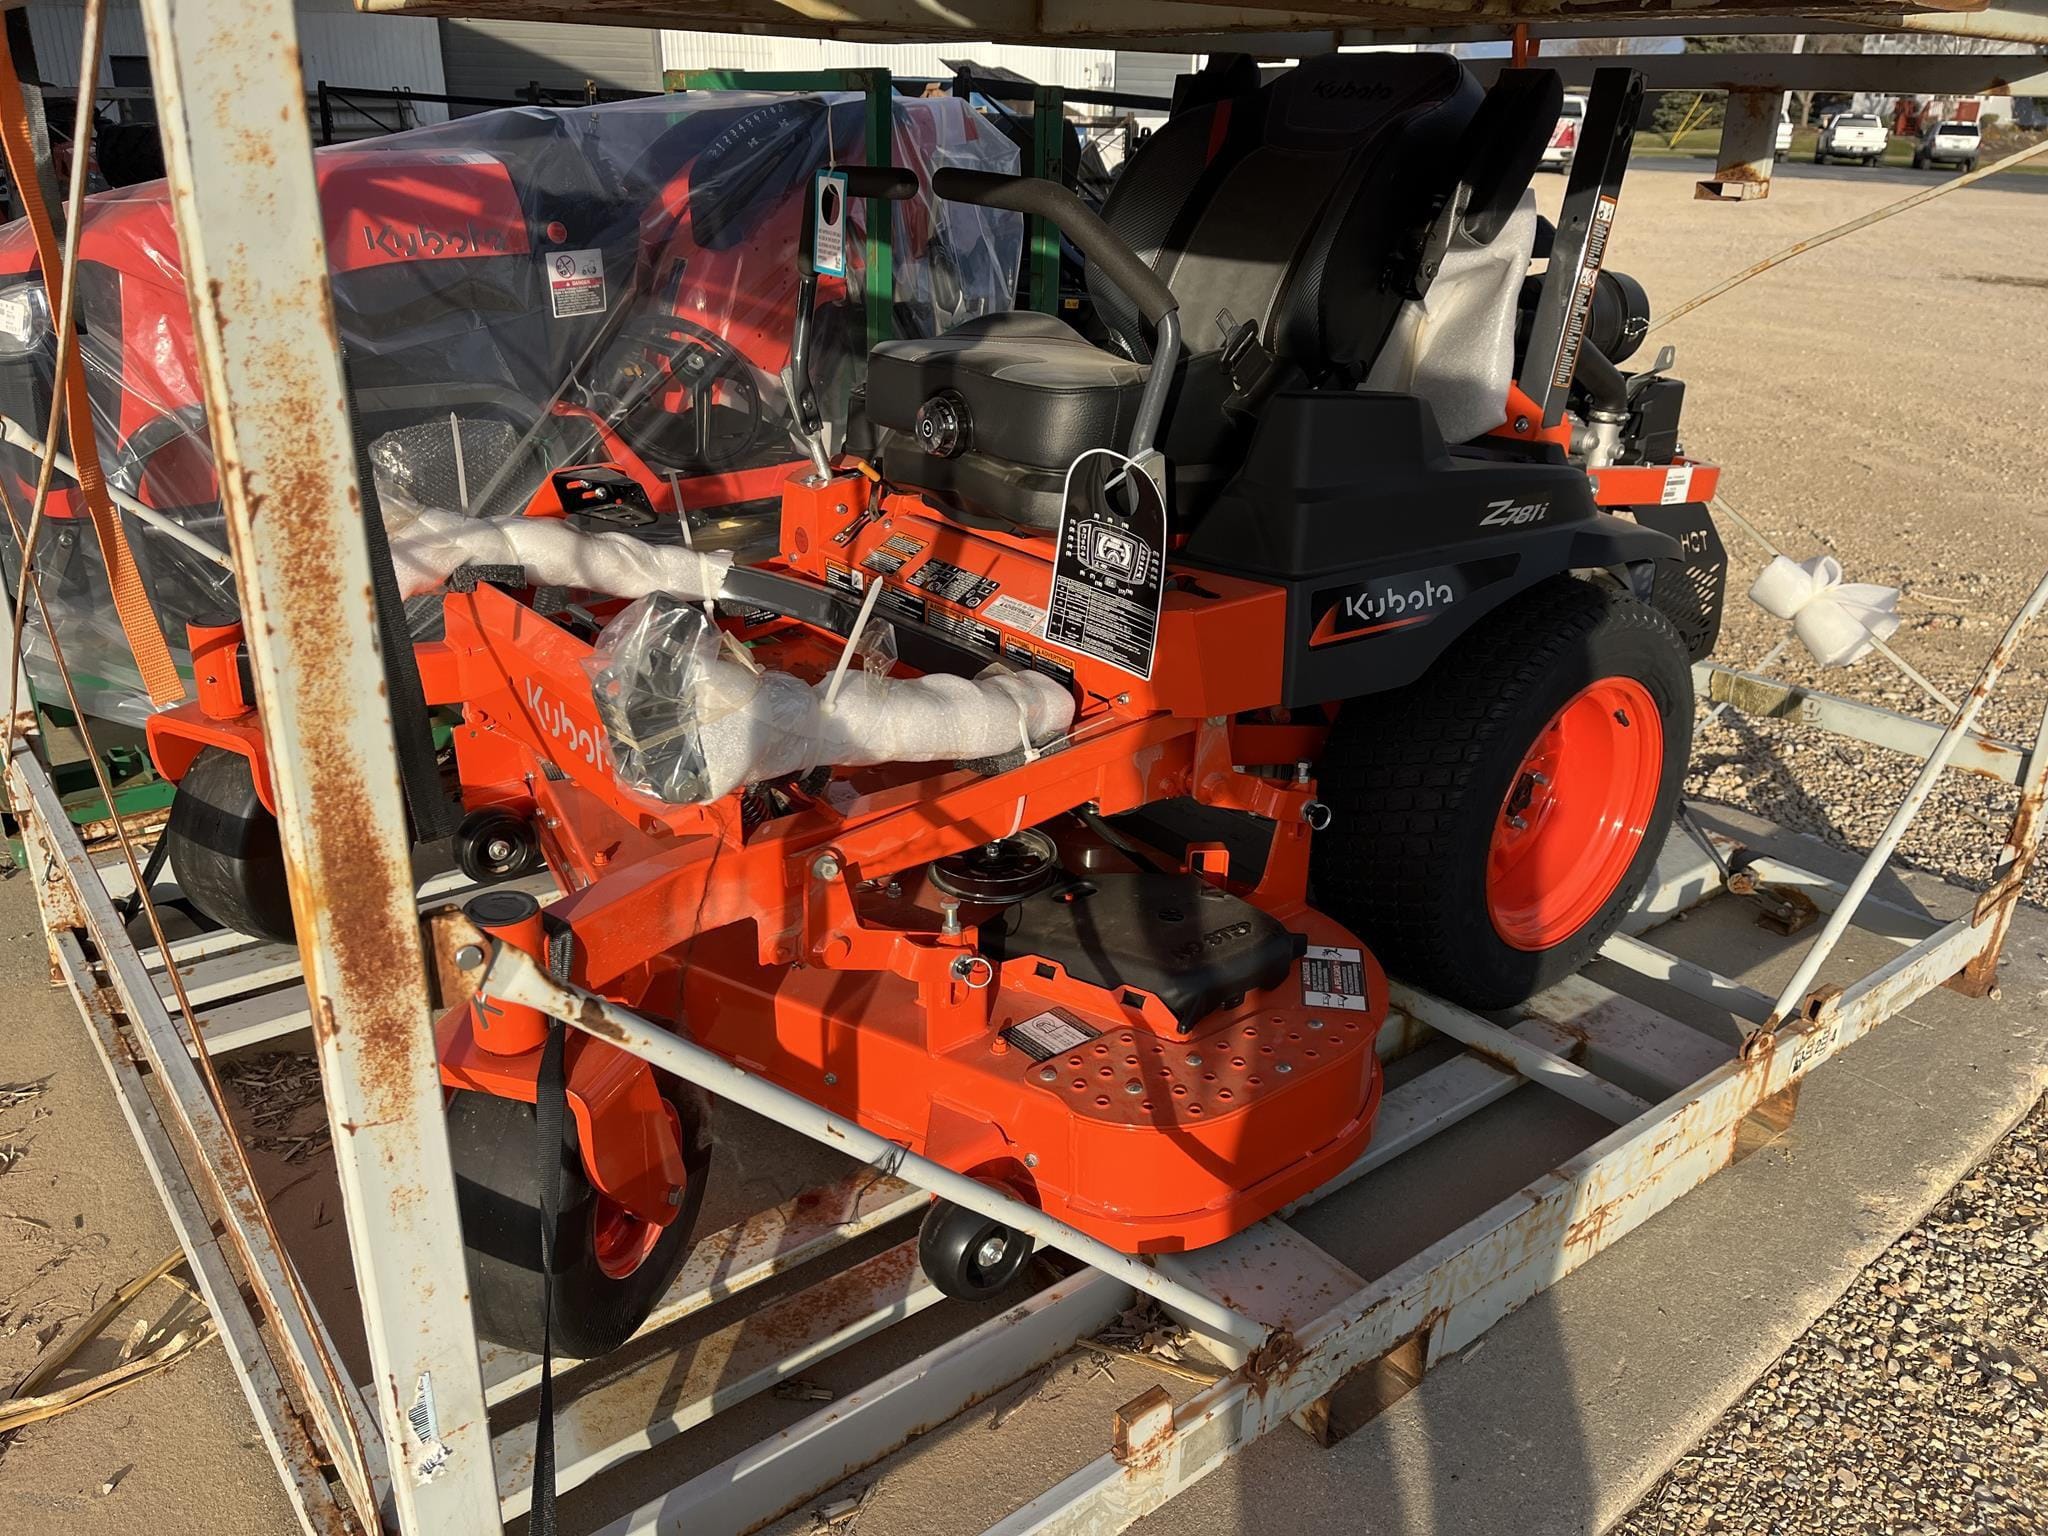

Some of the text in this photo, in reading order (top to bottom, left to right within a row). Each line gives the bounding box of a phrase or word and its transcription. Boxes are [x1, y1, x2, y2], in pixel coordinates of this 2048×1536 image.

[1311, 80, 1392, 99] Kubota
[363, 219, 507, 258] Kubota
[1479, 499, 1550, 526] Z781i
[1680, 529, 1708, 553] HOT
[1346, 580, 1454, 620] Kubota
[1041, 649, 1074, 667] ADVERTENCIA
[526, 677, 610, 772] Kubot
